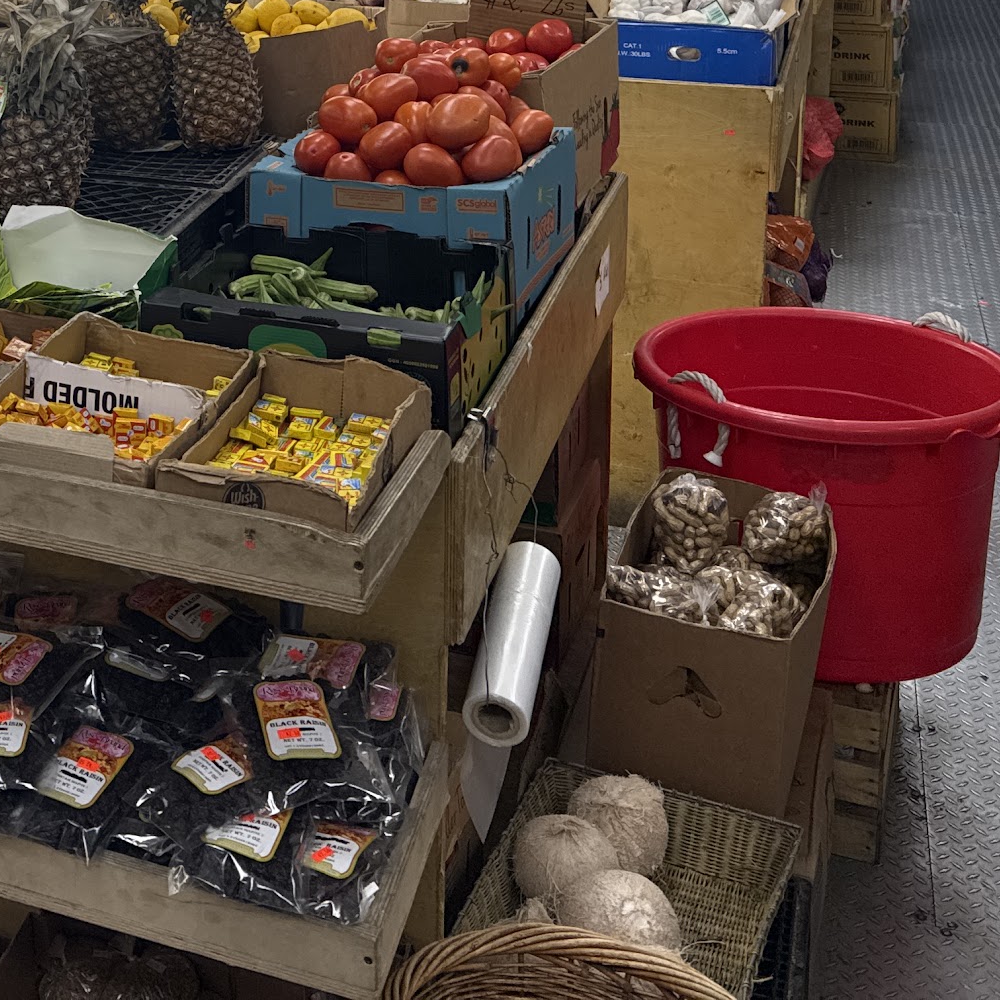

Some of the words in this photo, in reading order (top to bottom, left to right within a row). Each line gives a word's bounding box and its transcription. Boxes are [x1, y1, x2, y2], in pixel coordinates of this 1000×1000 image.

[833, 51, 872, 61] DRINK
[840, 118, 876, 128] DRINK
[43, 380, 140, 415] MOLDED
[269, 719, 298, 728] BLACK
[299, 719, 327, 728] RAISIN
[79, 767, 104, 783] RAISIN
